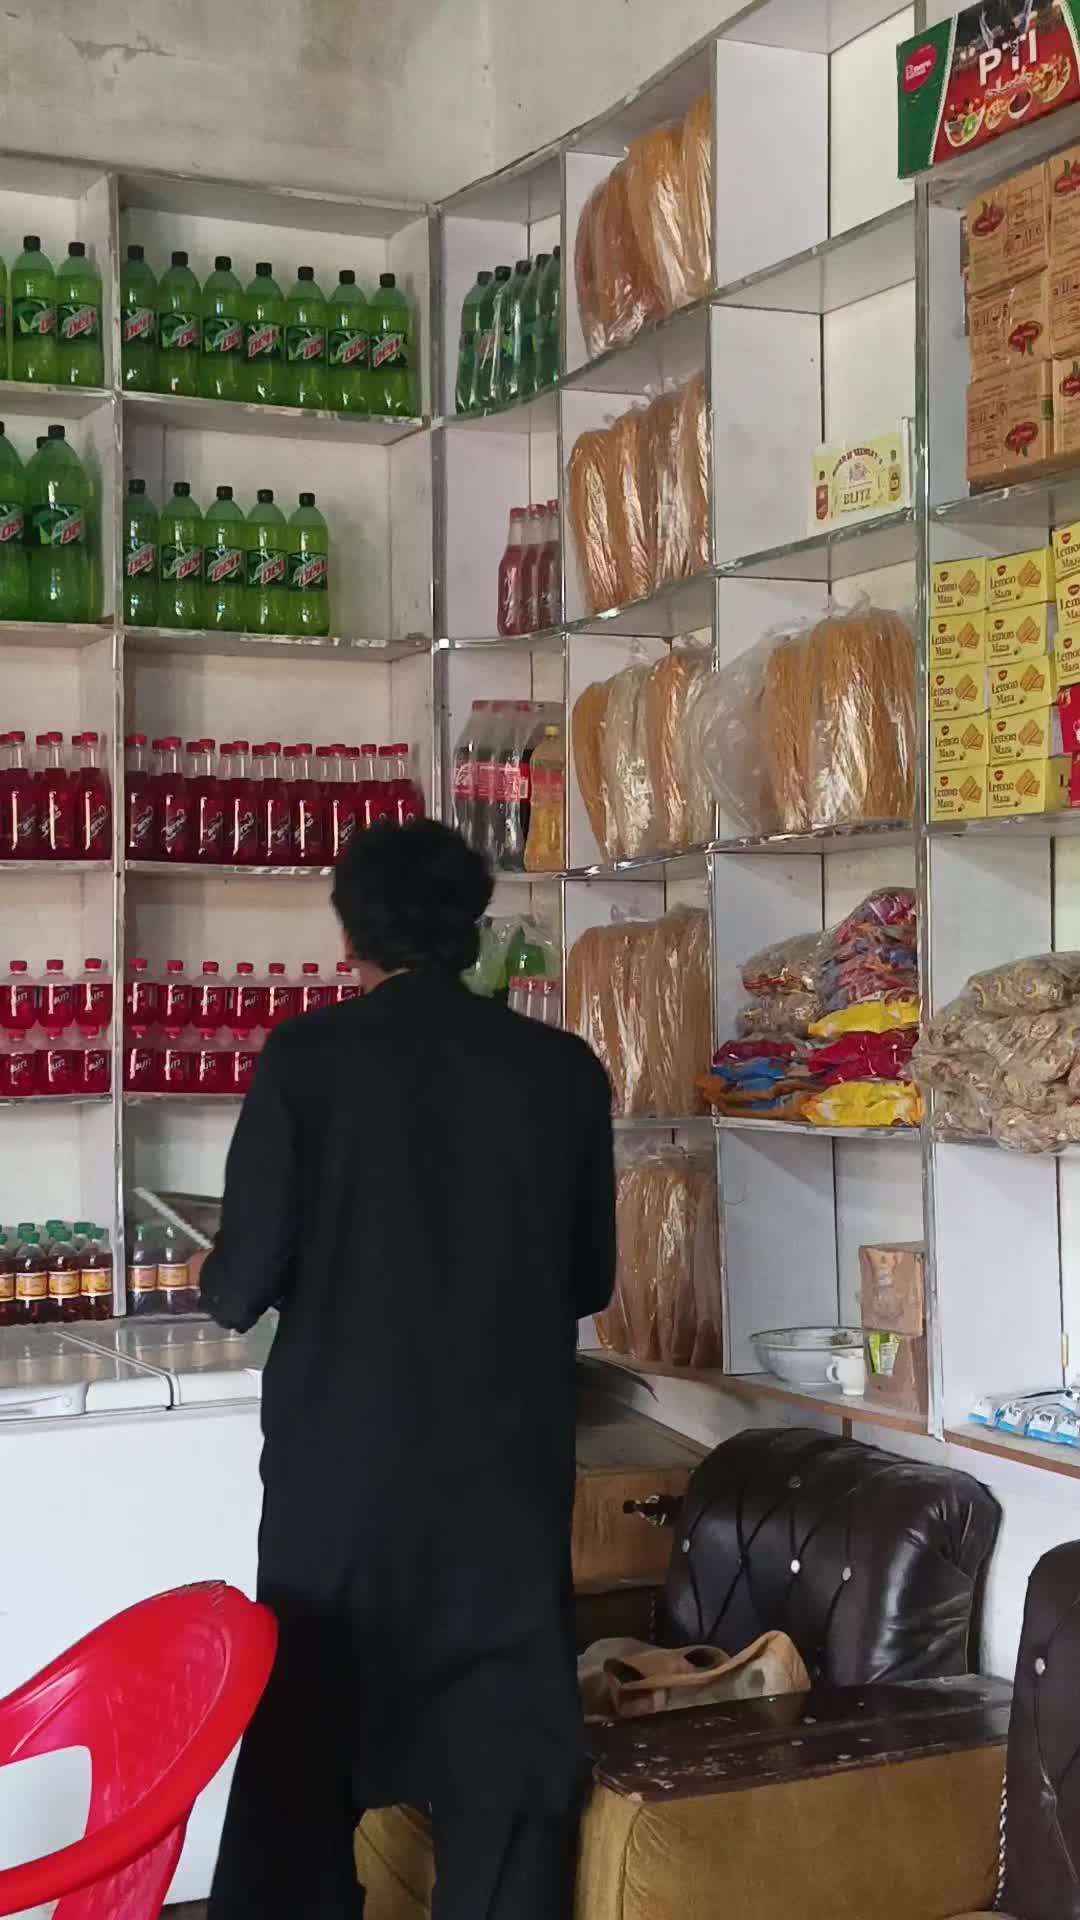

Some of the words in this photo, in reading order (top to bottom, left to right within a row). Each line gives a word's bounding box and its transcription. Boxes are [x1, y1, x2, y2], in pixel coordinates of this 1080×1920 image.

[1056, 544, 1080, 559] Lemo
[934, 582, 958, 593] Lemon
[990, 575, 1016, 589] Lemon
[1060, 597, 1080, 611] Lem
[932, 634, 955, 645] Lemon
[988, 630, 1015, 642] Lemon
[931, 687, 954, 697] Lemon
[992, 680, 1018, 694] Lemon
[935, 736, 959, 747] Lemon
[991, 733, 1017, 744] Lemon
[934, 787, 958, 797] Lemon
[988, 781, 1014, 792] Lemon
